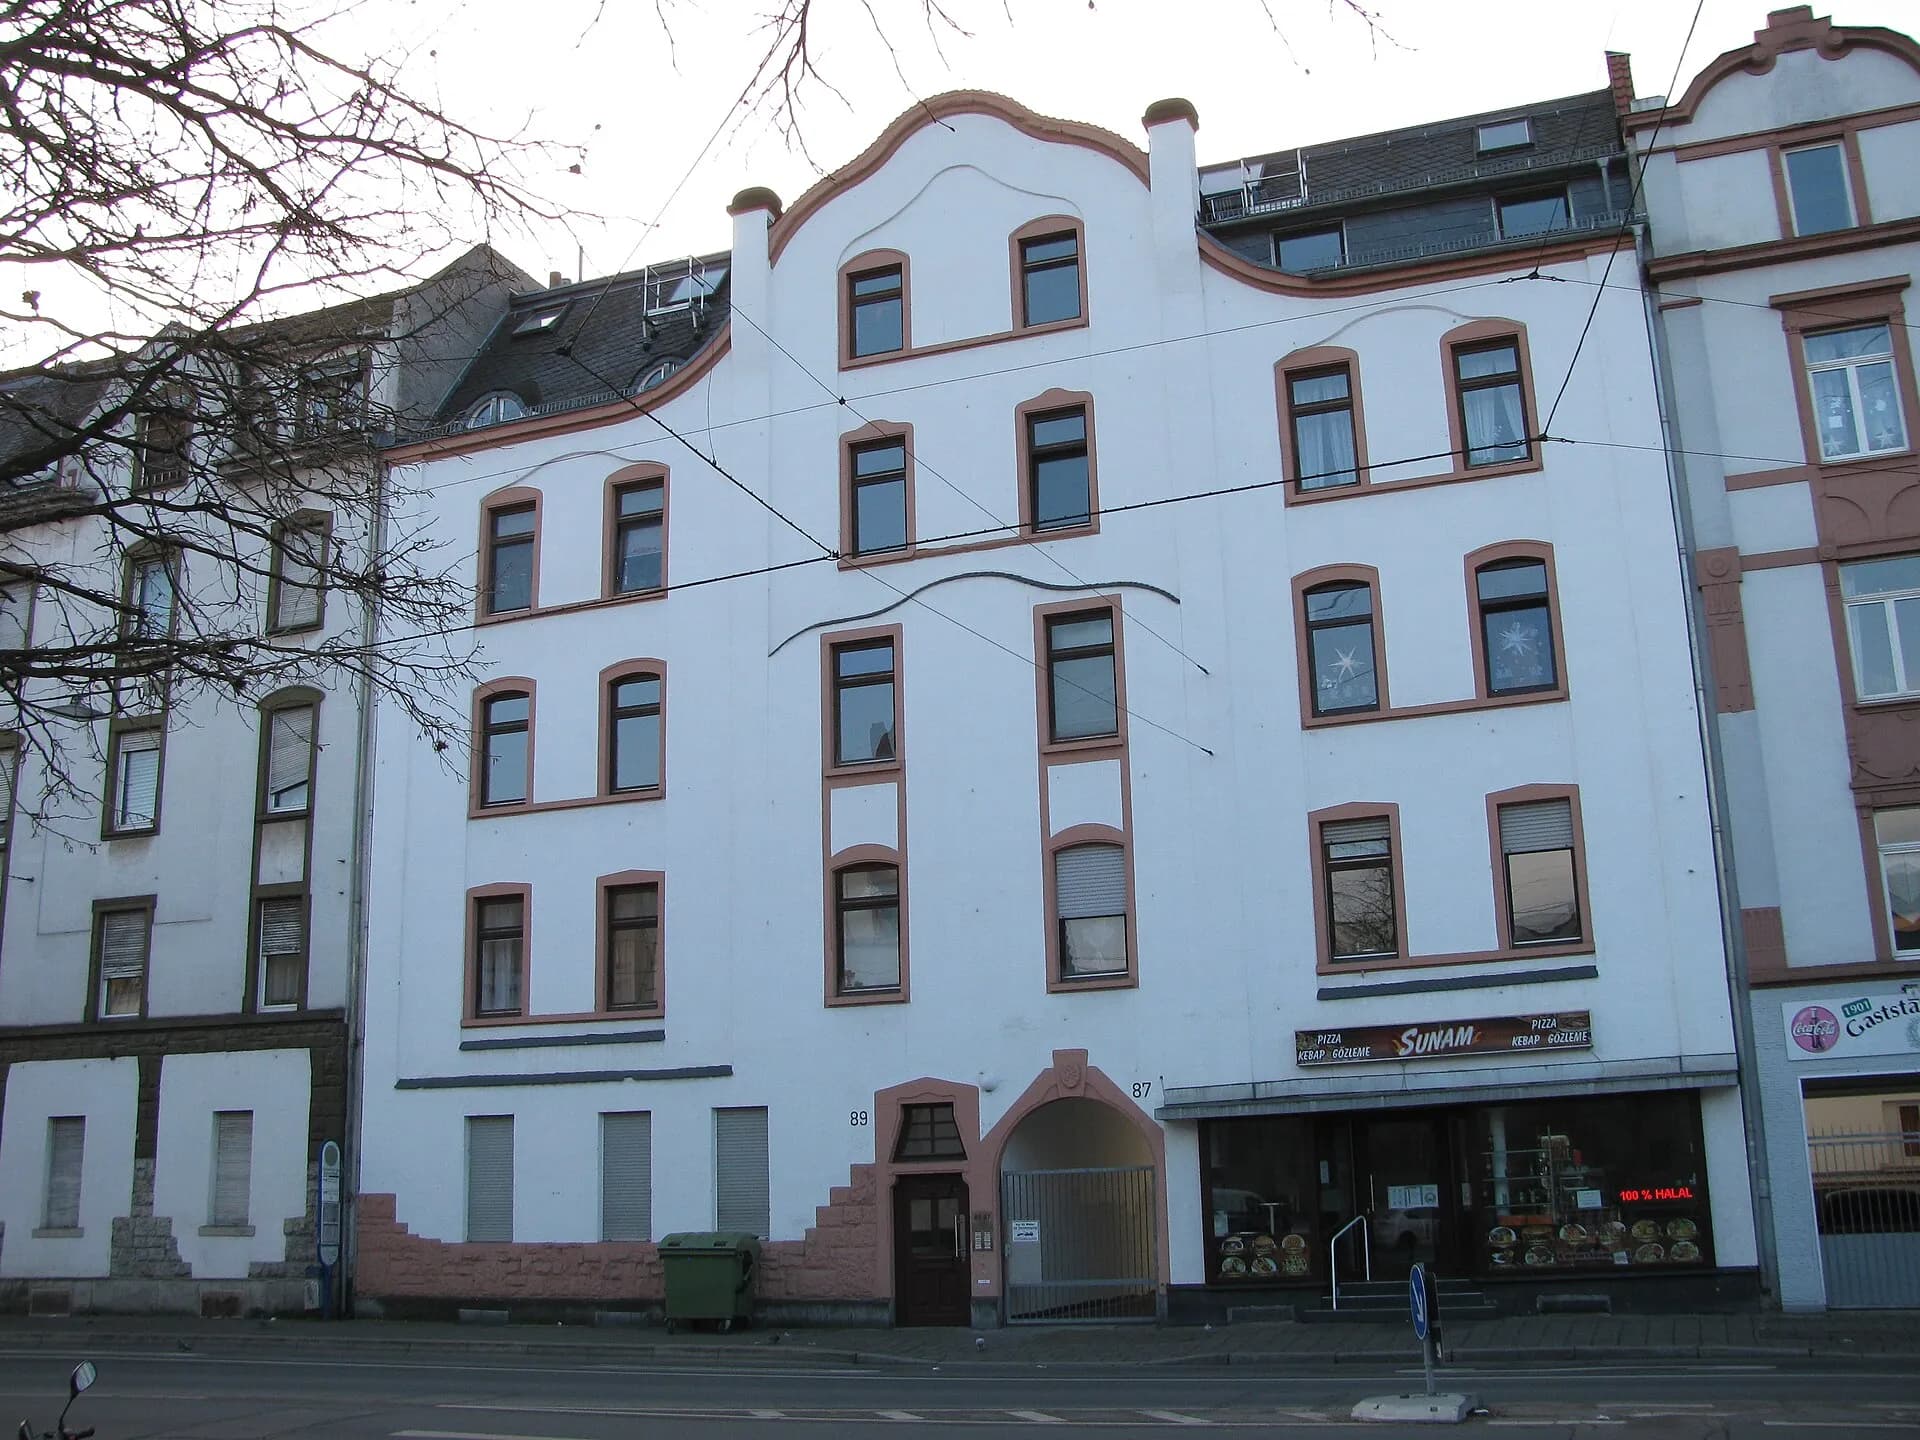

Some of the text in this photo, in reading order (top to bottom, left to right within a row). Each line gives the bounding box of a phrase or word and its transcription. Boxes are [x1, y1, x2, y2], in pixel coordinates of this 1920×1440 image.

[1532, 1018, 1557, 1030] PIZZA
[1317, 1033, 1342, 1045] PIZZA
[1399, 1025, 1474, 1056] SUNAM
[1512, 1034, 1541, 1047] KEBAP
[1298, 1046, 1371, 1061] KEBAP GÖZLEME
[1132, 1082, 1151, 1098] 87
[850, 1110, 867, 1126] 89
[1619, 1187, 1693, 1201] 100 % HALAL
